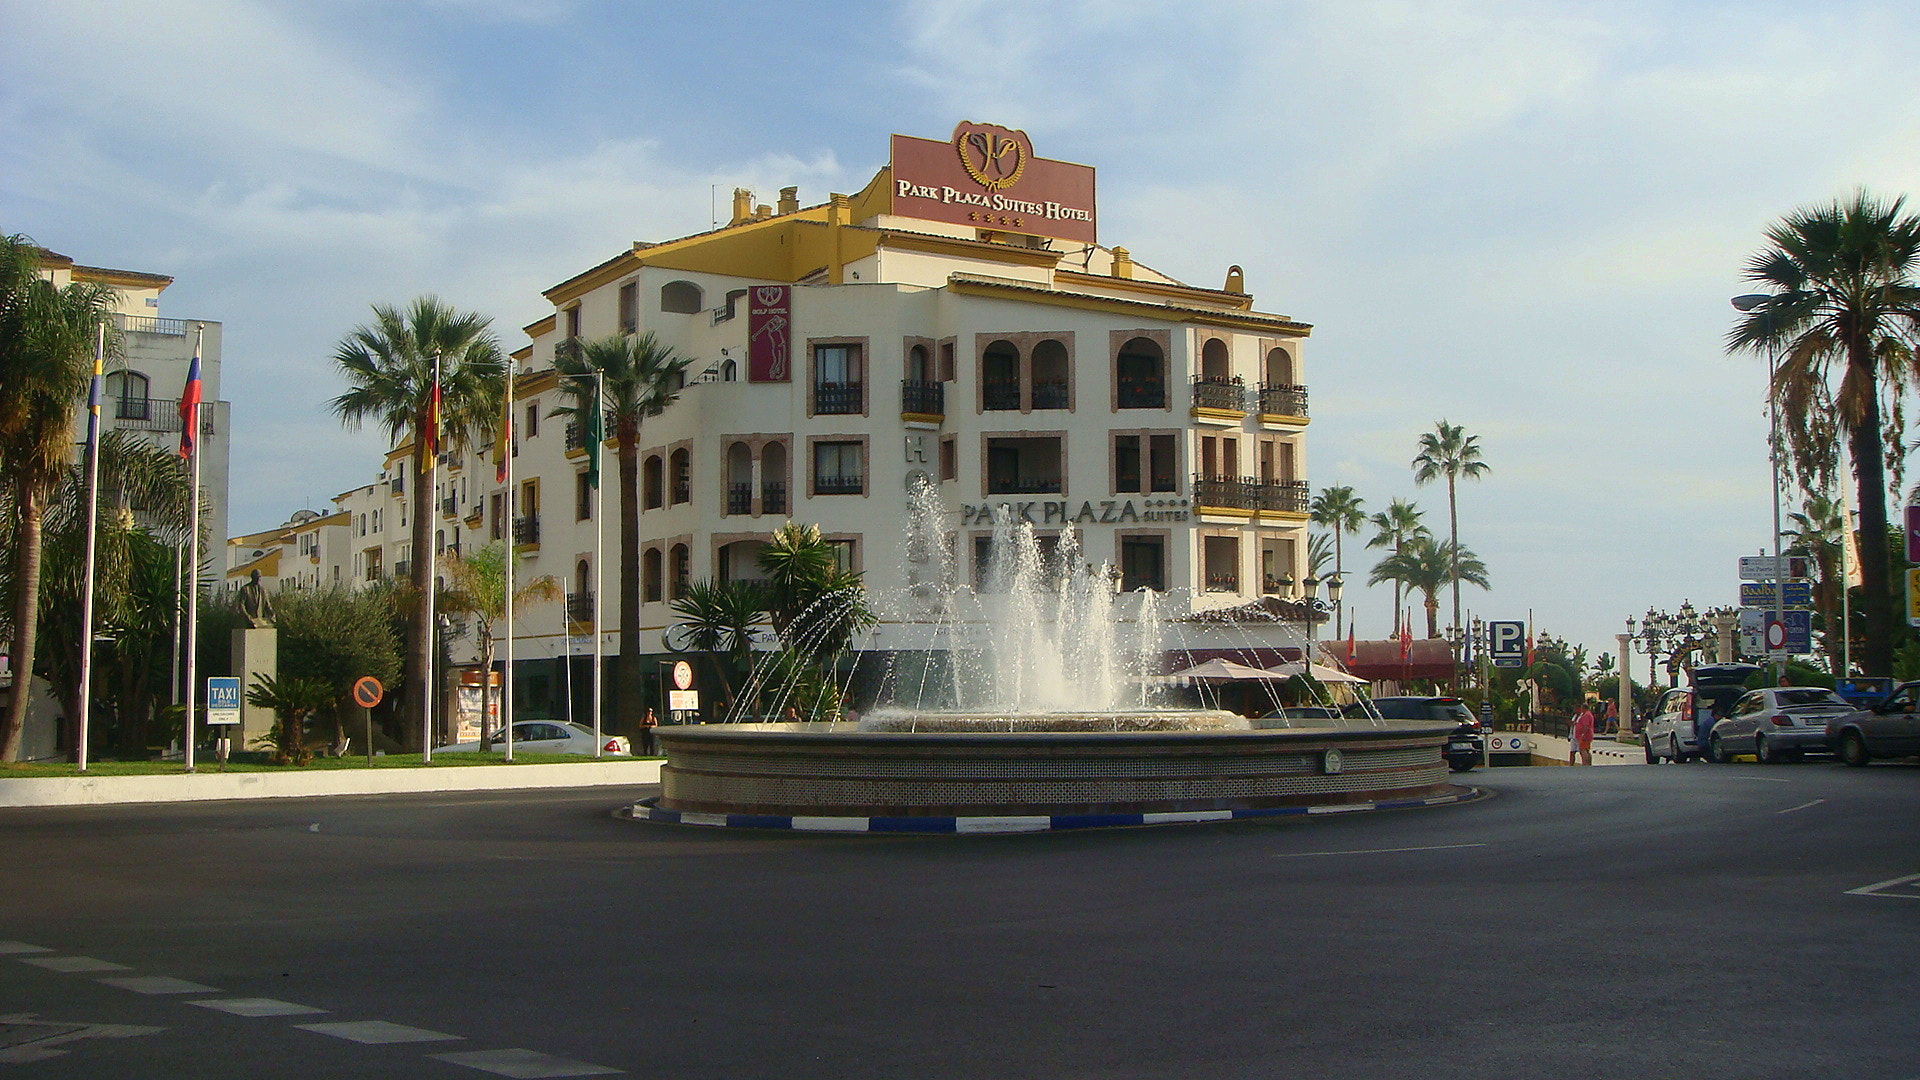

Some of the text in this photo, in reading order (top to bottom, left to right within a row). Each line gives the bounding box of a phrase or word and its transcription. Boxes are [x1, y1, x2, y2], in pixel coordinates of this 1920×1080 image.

[961, 499, 1140, 526] PAK PLAZA
[1143, 510, 1189, 523] SUITES
[1495, 623, 1521, 652] P
[211, 687, 237, 700] TAXI
